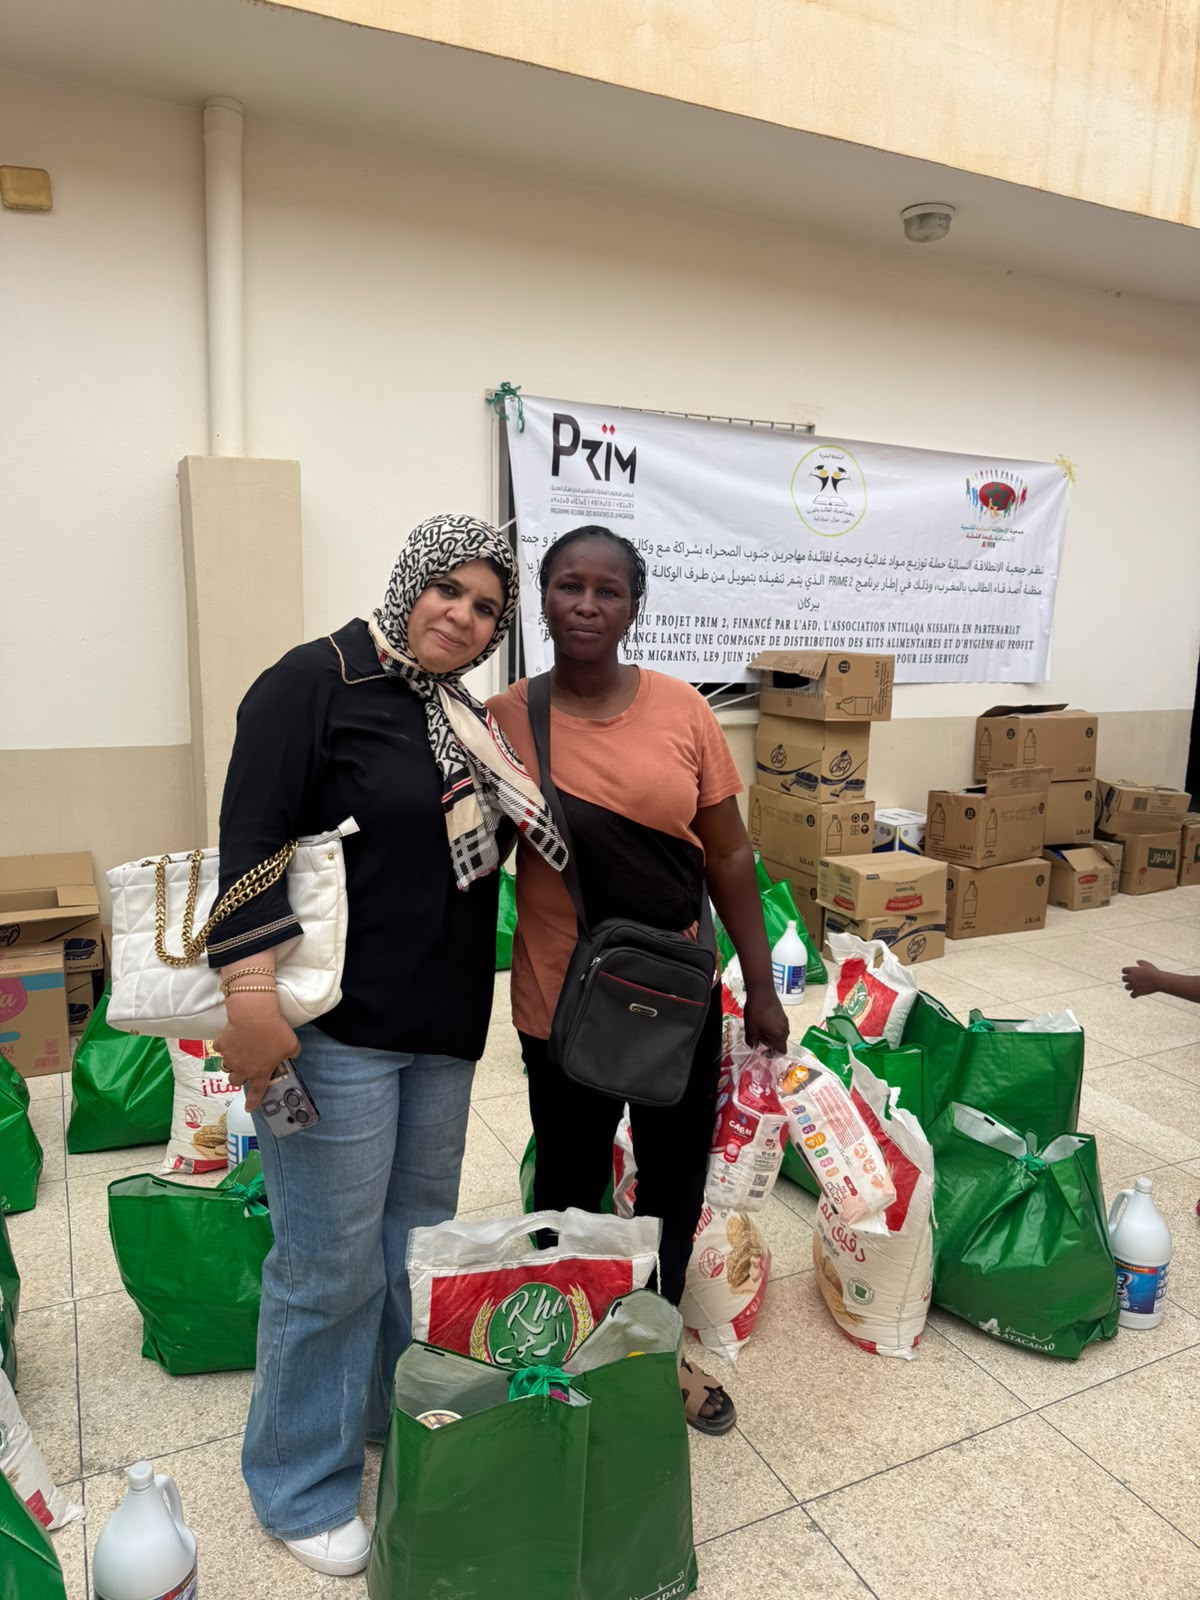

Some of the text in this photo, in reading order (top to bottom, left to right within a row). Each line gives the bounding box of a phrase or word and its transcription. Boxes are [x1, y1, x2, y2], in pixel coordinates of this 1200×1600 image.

[656, 544, 671, 558] مع
[672, 540, 703, 558] بشراكة
[705, 543, 742, 559] الصحراء
[743, 549, 770, 562] جنوب
[771, 549, 806, 564] مهاجرين
[807, 550, 833, 563] لفائدة
[834, 550, 863, 567] وصحية
[888, 554, 906, 570] مواد
[906, 557, 928, 572] توزيع
[928, 557, 946, 569] حملة
[651, 564, 682, 582] الوكالة
[684, 567, 709, 583] طرف
[1005, 562, 1026, 576] جمعية
[711, 572, 726, 584] من
[727, 569, 757, 586] بتمويل
[757, 571, 785, 587] تنفيذه
[786, 575, 803, 588] يتم
[804, 574, 825, 591] الذي
[854, 576, 880, 593] برنامج
[880, 577, 899, 592] إطار
[899, 578, 912, 596] في
[912, 579, 934, 594] وذلك
[968, 582, 993, 596] الطالب
[655, 614, 691, 629] PROJET
[694, 616, 718, 628] PRIM
[721, 618, 730, 629] 2,
[732, 617, 772, 630] FINANCÉ
[775, 619, 791, 630] PAR
[793, 619, 821, 632] L'AFD,
[823, 620, 885, 632] L'ASSOCIATION
[887, 622, 925, 635] INTILAQA
[962, 624, 972, 634] EN
[973, 624, 1021, 635] PARTENARIAT
[660, 633, 692, 645] LANCE
[695, 634, 714, 645] UNE
[716, 634, 766, 646] COMPAGNE
[768, 635, 781, 647] DE
[783, 636, 845, 648] DISTRIBUTION
[847, 637, 864, 648] DES
[865, 637, 884, 649] KITS
[885, 638, 942, 649] ALIMENTAIRES
[943, 639, 953, 649] ET
[954, 638, 995, 650] D'HYGIÈNE
[995, 640, 1006, 650] AU
[1007, 640, 1034, 650] PROFIT
[626, 649, 644, 661] DES
[647, 650, 700, 663] MIGRANTS,
[721, 652, 744, 664] JUIN
[896, 654, 917, 664] POUR
[919, 654, 933, 664] LES
[934, 654, 969, 664] SERVICES
